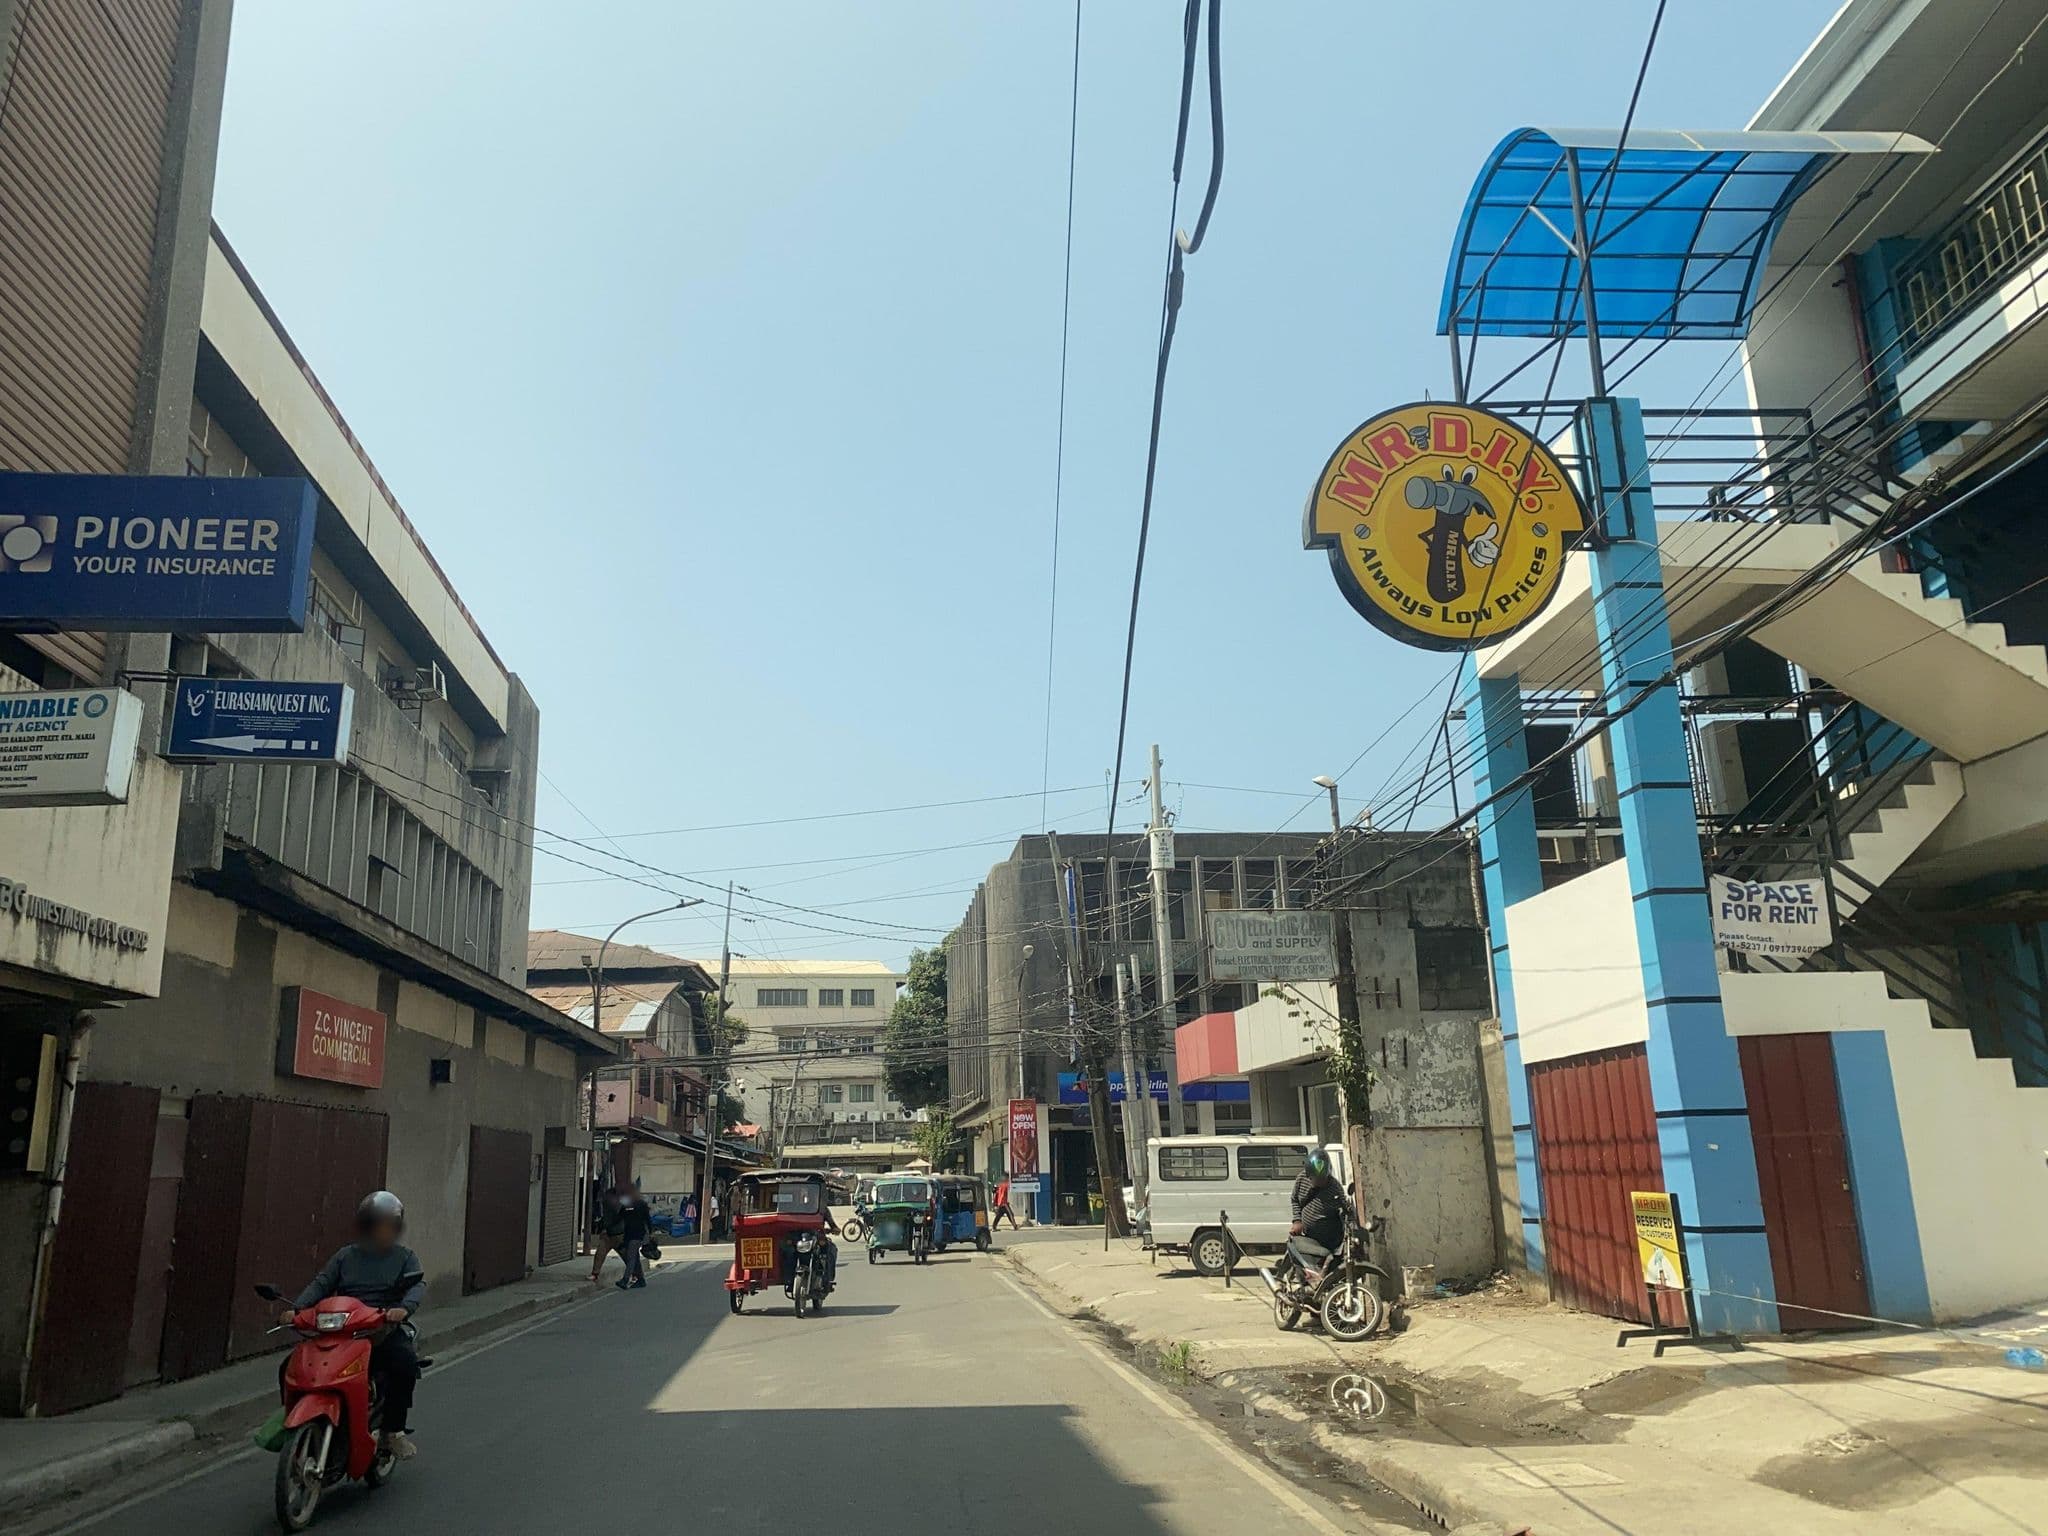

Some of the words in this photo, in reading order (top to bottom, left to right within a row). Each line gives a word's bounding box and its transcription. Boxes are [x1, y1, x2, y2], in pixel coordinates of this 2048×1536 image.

[74, 516, 280, 551] PIONEER
[72, 556, 136, 574] YOUR
[147, 557, 276, 575] INSURANCE
[1358, 546, 1433, 618] Always
[1441, 606, 1492, 624] Low
[1495, 546, 1547, 614] Prices
[308, 694, 331, 714] INC.
[15, 720, 68, 732] AGENCY
[1726, 882, 1813, 904] SPACE
[1722, 902, 1761, 922] FOR
[1769, 905, 1818, 924] RENT
[1252, 939, 1272, 949] and
[1275, 937, 1322, 949] SUPPLY
[1719, 932, 1744, 940] Please
[314, 1010, 331, 1034] Z.C.
[333, 1015, 374, 1044] VINCENT
[312, 1034, 372, 1066] COMMERCIAL
[1013, 1114, 1033, 1122] NOW
[1636, 1215, 1672, 1228] RESERVED
